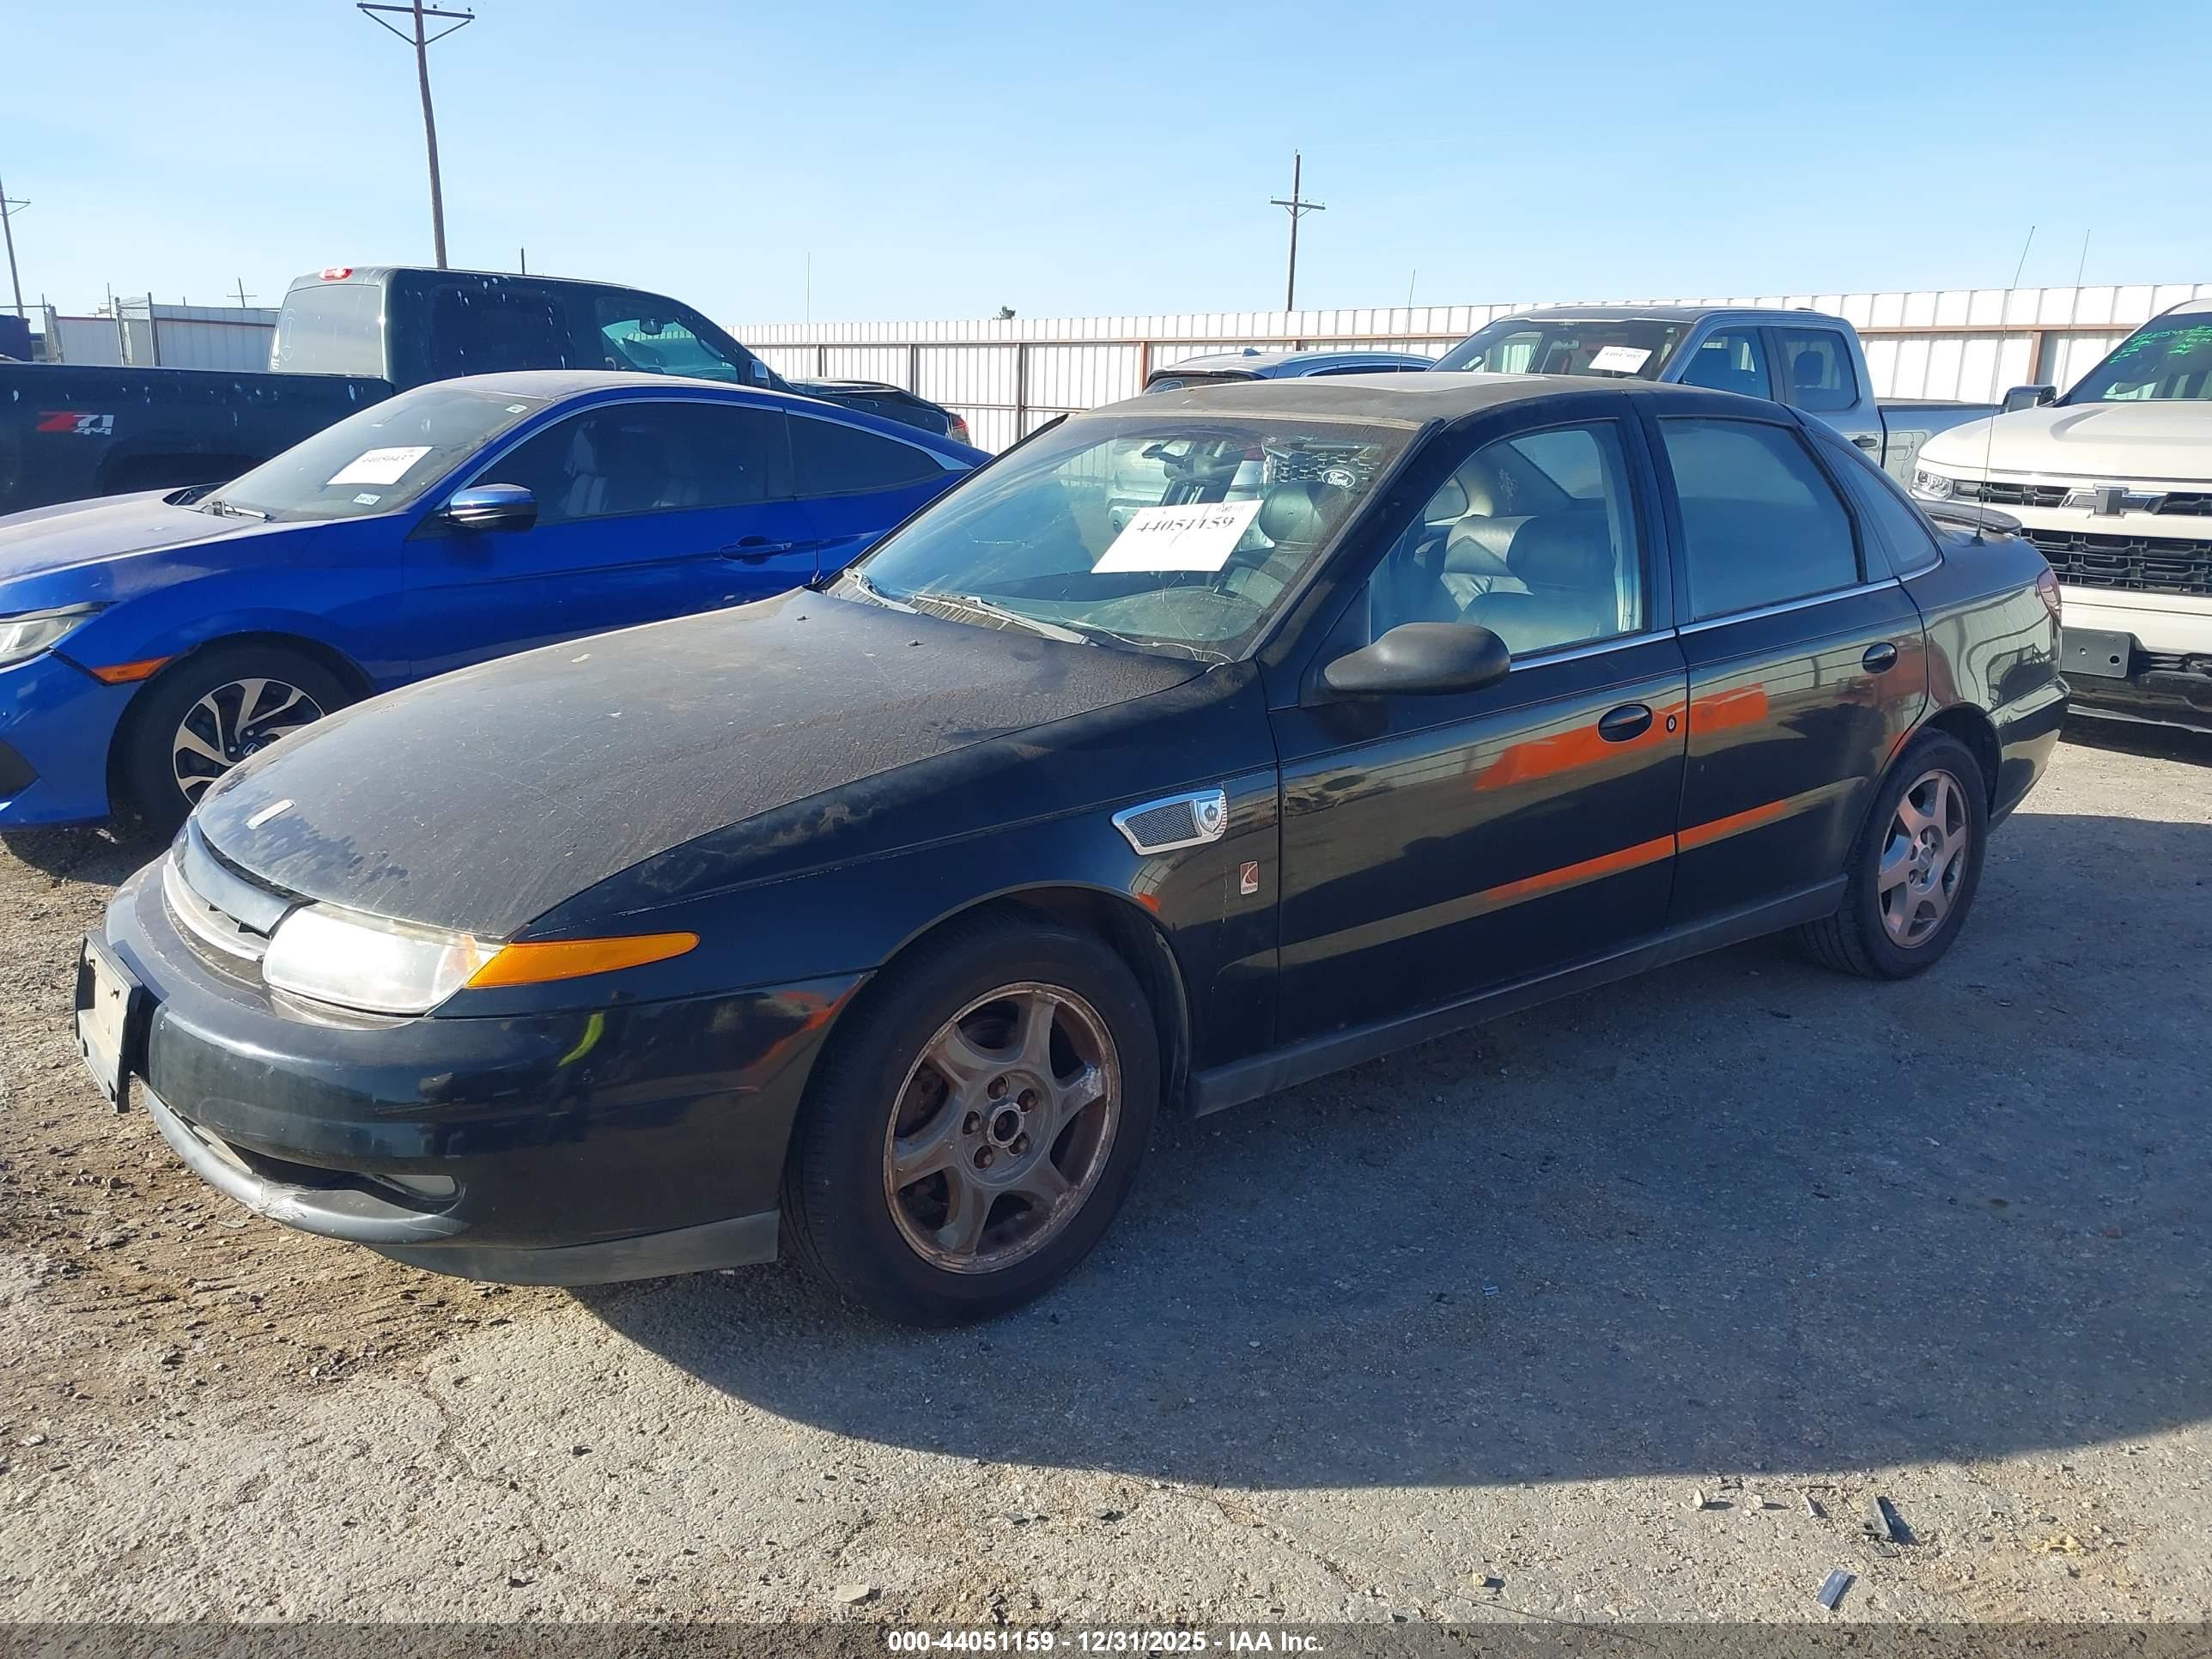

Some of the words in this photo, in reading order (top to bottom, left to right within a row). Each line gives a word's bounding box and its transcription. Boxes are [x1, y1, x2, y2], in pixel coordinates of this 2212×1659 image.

[37, 412, 114, 431] Z71
[1328, 471, 1348, 485] Ford
[1136, 516, 1236, 532] 44051159
